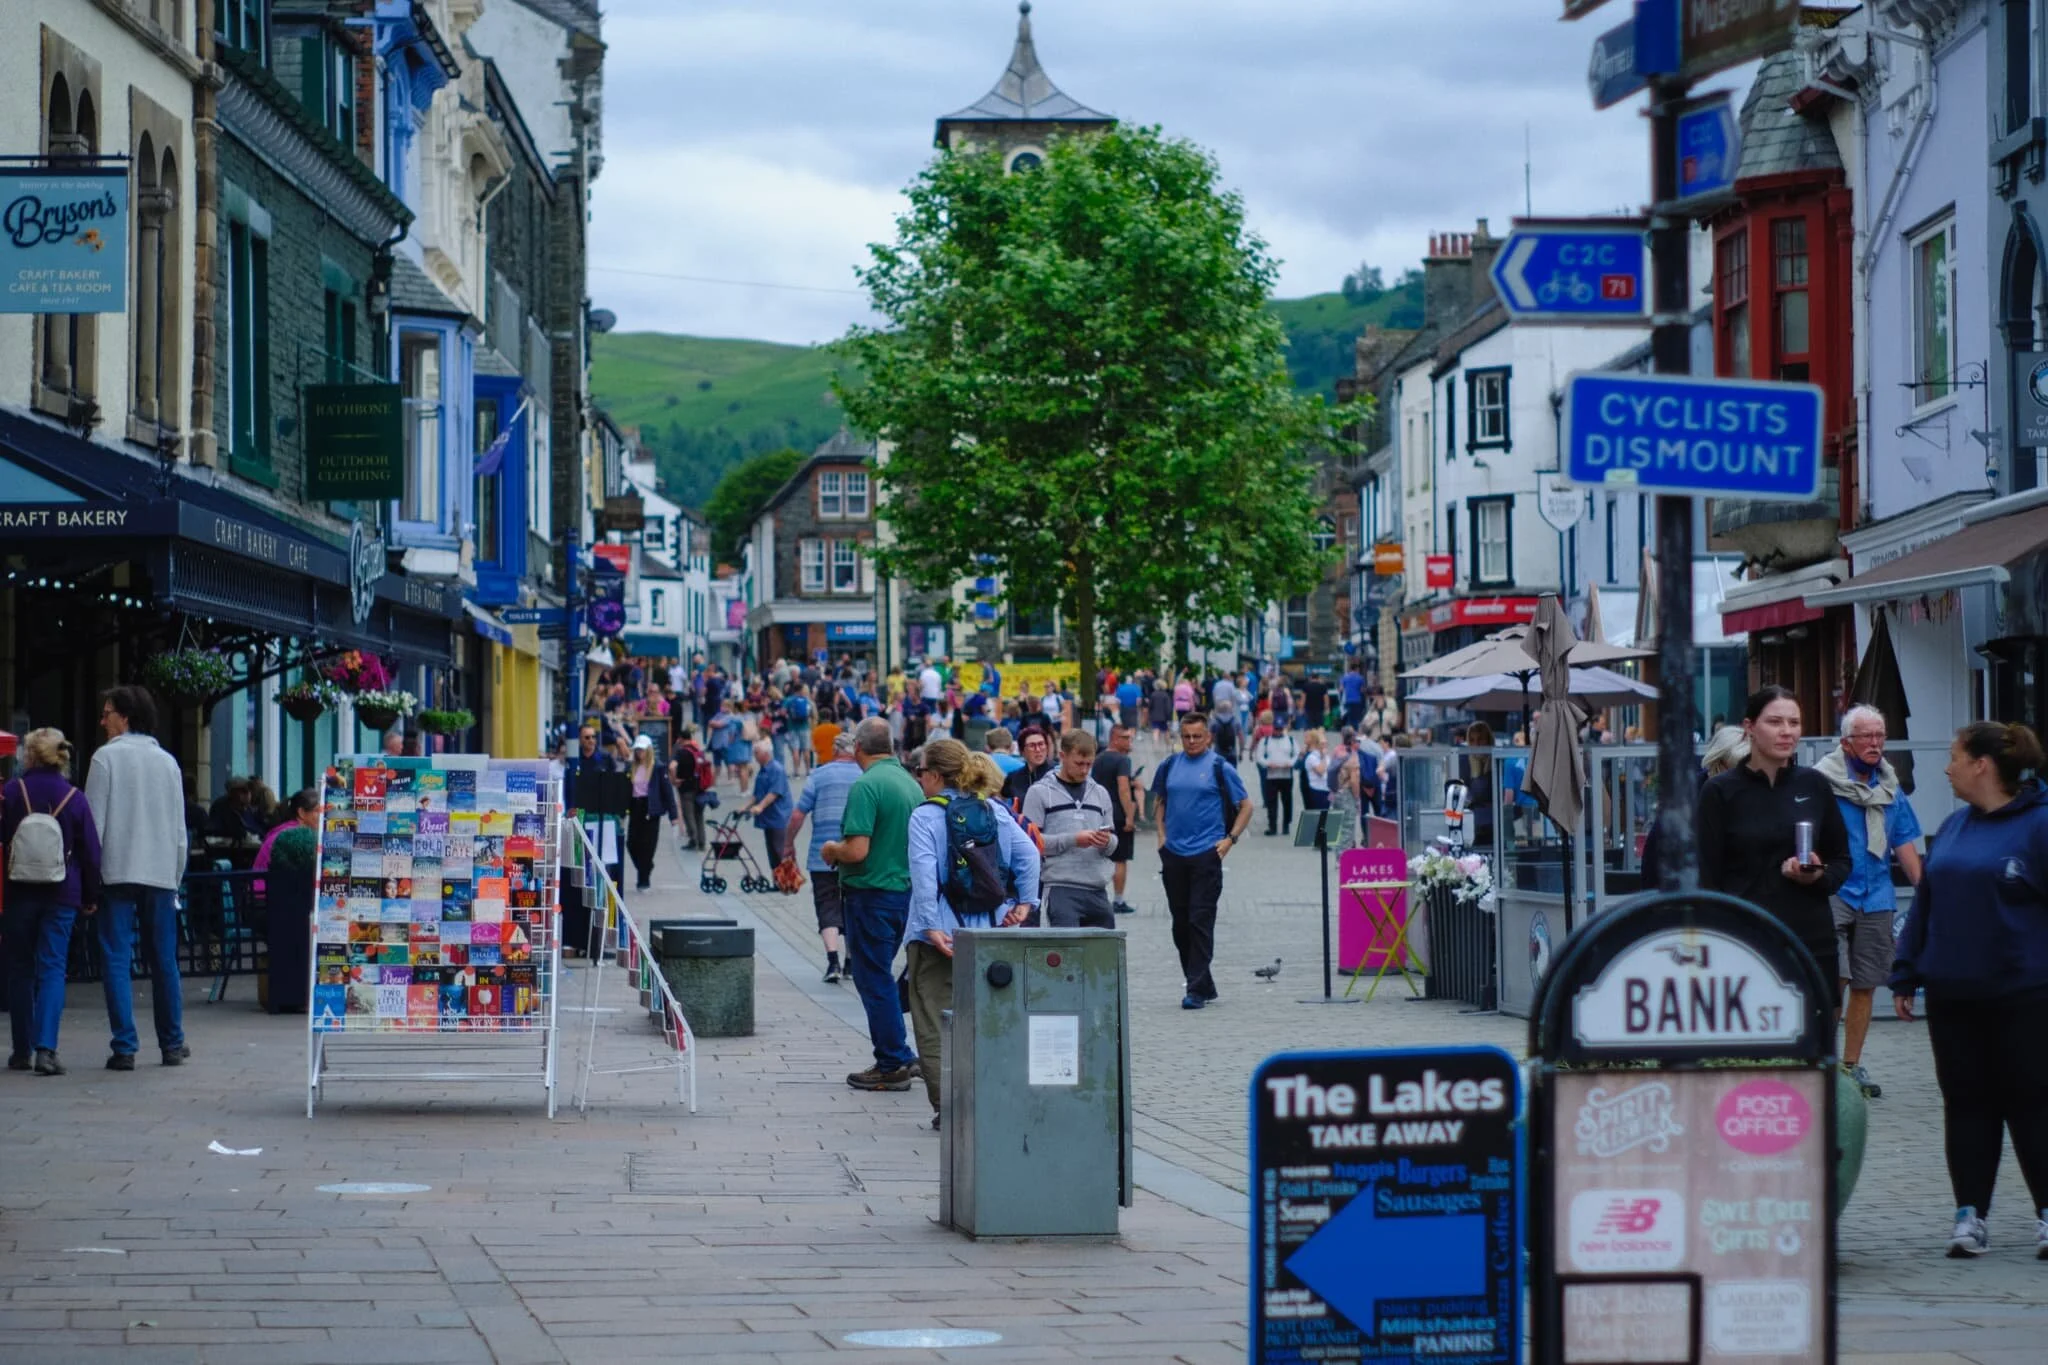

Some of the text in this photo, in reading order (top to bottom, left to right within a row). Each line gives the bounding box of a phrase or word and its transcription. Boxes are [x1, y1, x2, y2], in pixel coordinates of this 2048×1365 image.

[3, 190, 117, 249] Bryson's
[1558, 243, 1616, 266] C2C
[19, 270, 101, 281] CRAFT BAKERY
[40, 283, 49, 294] &
[52, 283, 73, 294] TEA
[76, 283, 112, 294] ROOM
[1608, 279, 1627, 296] 71
[316, 404, 391, 416] RATHBONE
[1601, 393, 1788, 436] CYCLISTS
[320, 455, 388, 466] OUTDOOR
[1584, 433, 1803, 476] DISMOUNT
[318, 471, 391, 481] CLOTHING
[0, 510, 128, 526] RAFT BAKERY
[215, 518, 243, 551] CRAFT
[247, 529, 278, 562] BAKERY
[1352, 864, 1394, 876] LAKES
[1625, 976, 1782, 1033] BANK ST
[1266, 1069, 1504, 1118] The Lakes
[1574, 1088, 1657, 1141] SPIRIT
[1736, 1095, 1792, 1114] POST
[1308, 1120, 1464, 1149] TAKE AWAY
[1724, 1116, 1801, 1136] OFFICE
[1398, 1158, 1467, 1187] Burgers
[1280, 1199, 1331, 1222] Scampi
[1377, 1188, 1482, 1213] Sausages
[1380, 1317, 1496, 1335] Milkshakes
[1414, 1333, 1494, 1353] PANINIS
